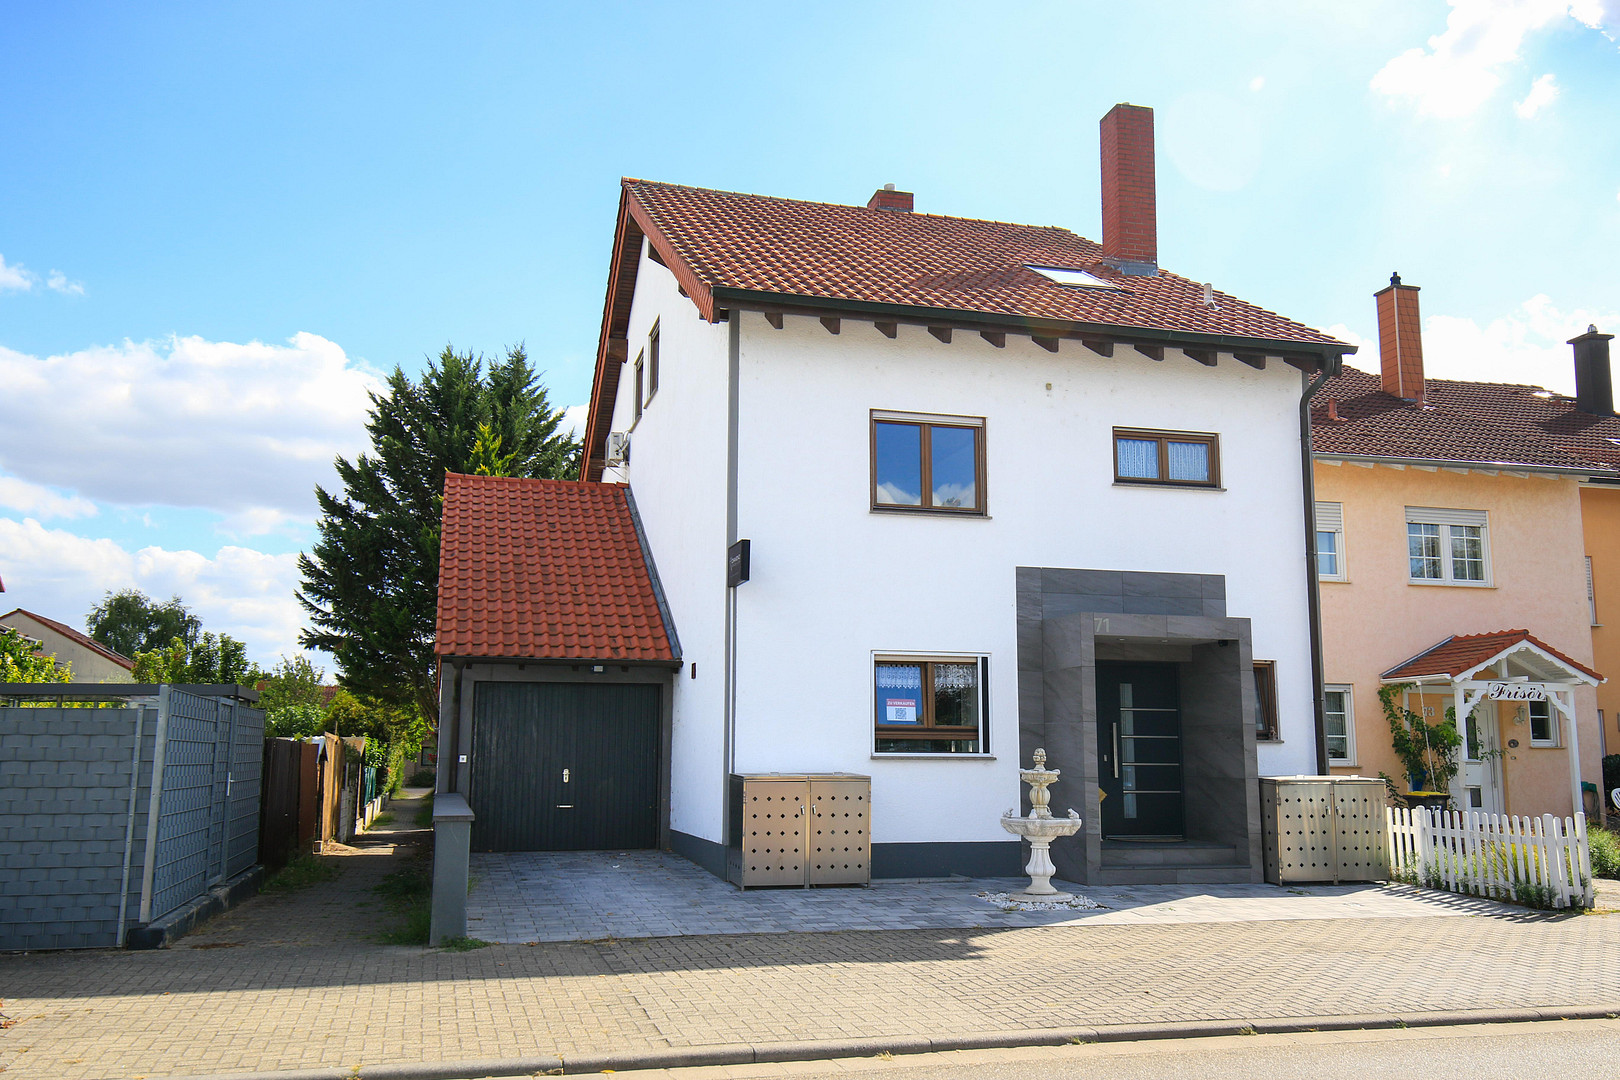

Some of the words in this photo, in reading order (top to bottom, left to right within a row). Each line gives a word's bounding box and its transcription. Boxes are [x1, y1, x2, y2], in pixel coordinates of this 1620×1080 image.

[1094, 618, 1109, 632] 71
[1490, 683, 1543, 699] Frisör
[1422, 706, 1434, 717] 73
